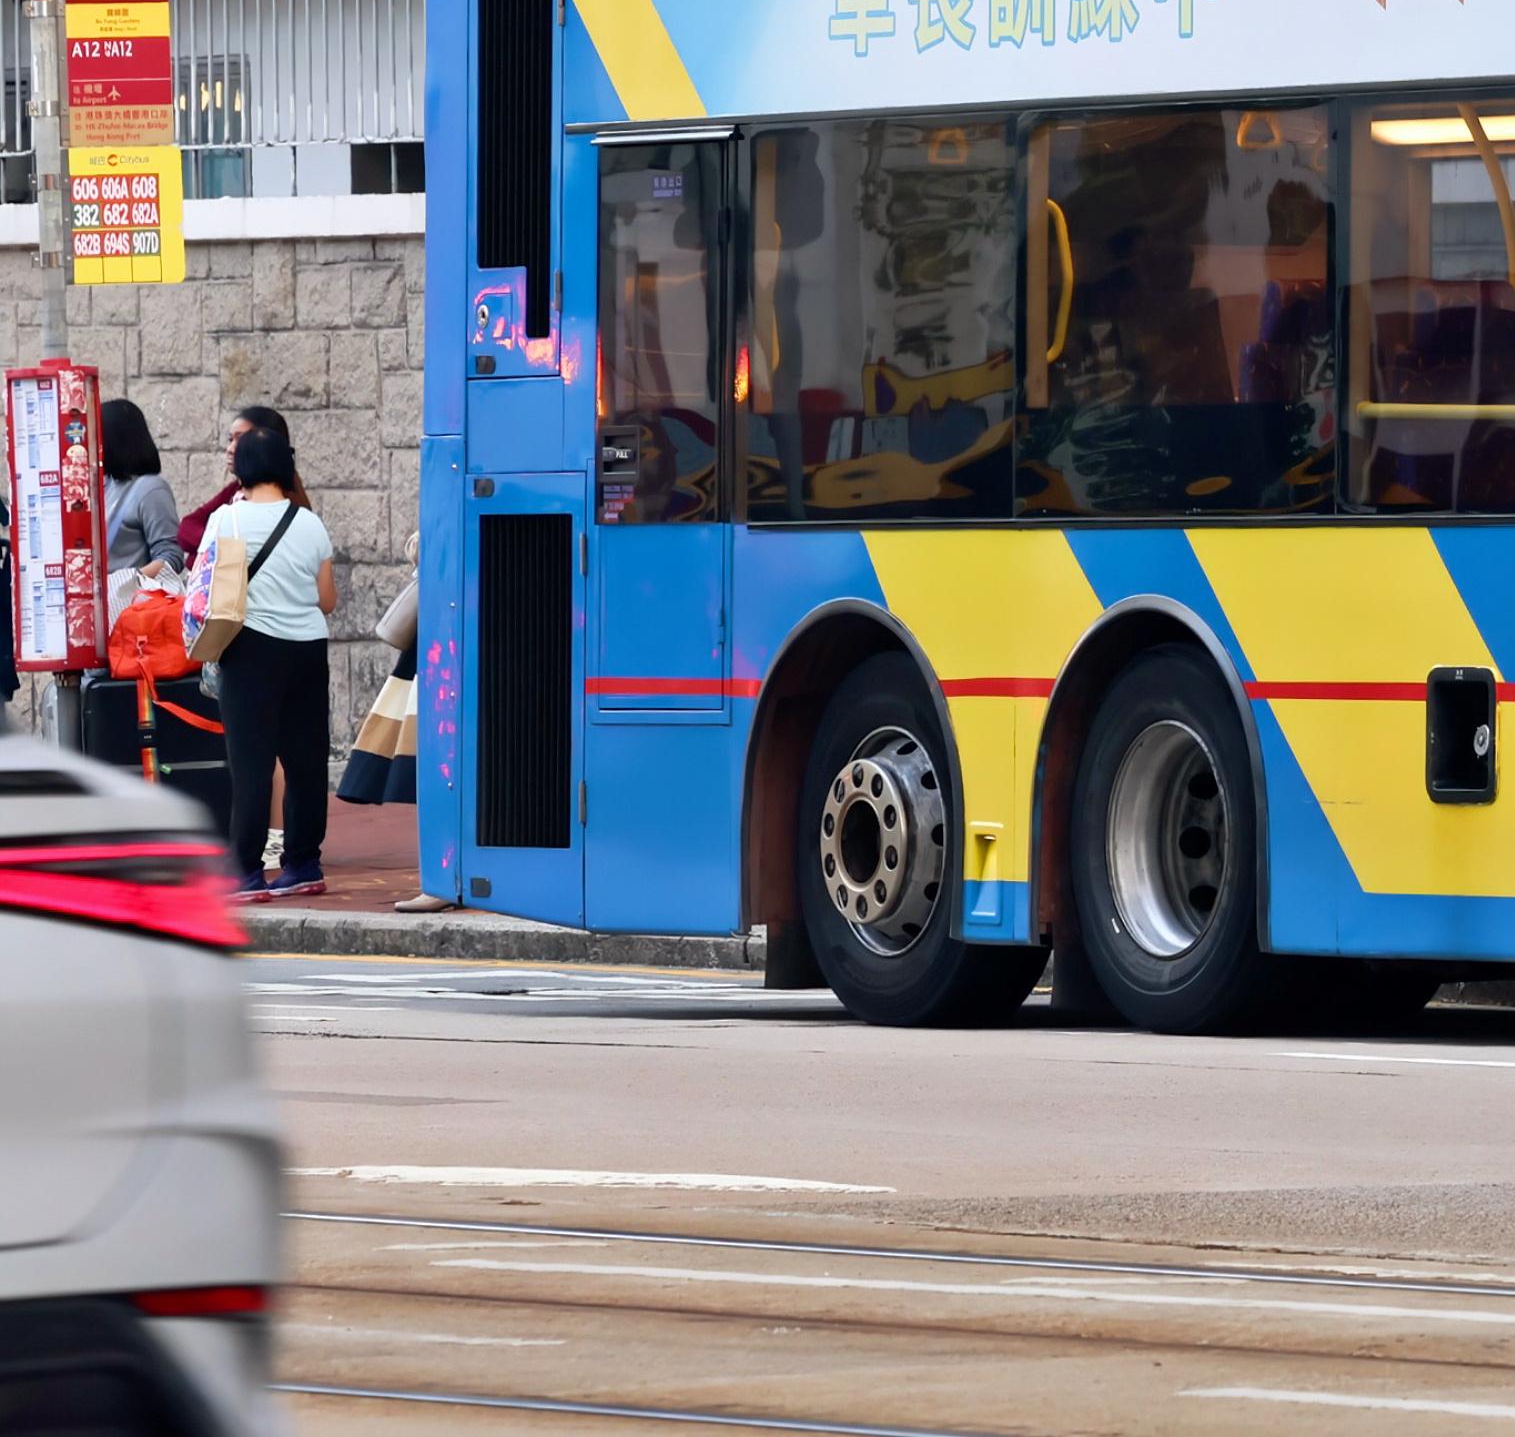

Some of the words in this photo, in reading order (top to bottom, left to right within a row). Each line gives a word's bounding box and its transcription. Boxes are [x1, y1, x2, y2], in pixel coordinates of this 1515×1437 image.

[71, 41, 100, 58] A12
[82, 96, 107, 106] Airport
[119, 156, 149, 166] Citybus
[73, 178, 98, 200] 606
[101, 177, 129, 199] 606A
[132, 176, 157, 199] 608
[74, 204, 99, 226] 382
[103, 204, 129, 225] 682
[132, 202, 159, 224] 682A
[74, 233, 101, 255] 682B
[103, 232, 130, 254] 694S
[132, 232, 159, 253] 907D
